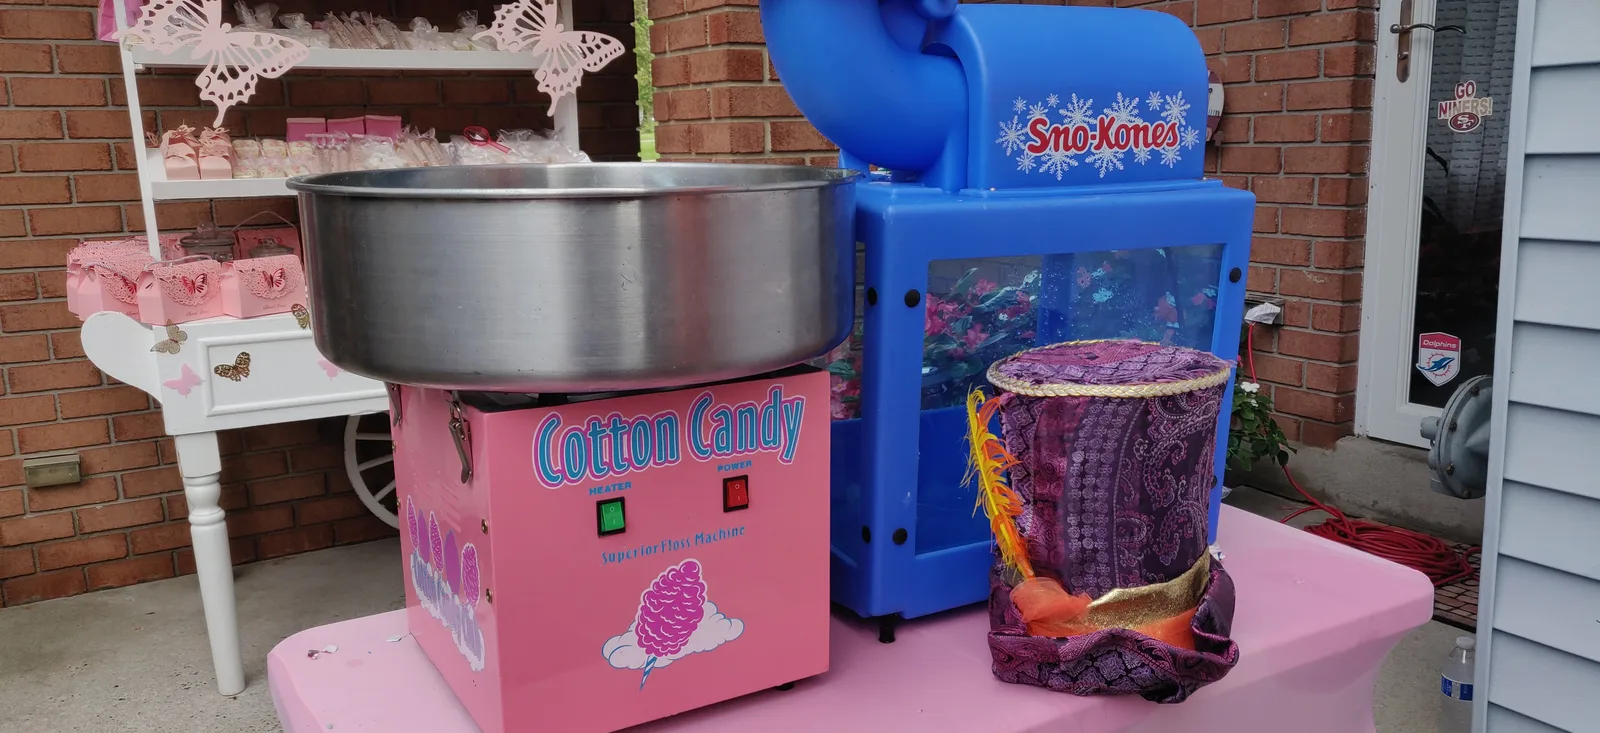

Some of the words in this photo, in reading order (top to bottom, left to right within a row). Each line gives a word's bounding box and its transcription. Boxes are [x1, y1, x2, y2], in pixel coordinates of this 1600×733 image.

[1456, 81, 1475, 99] GO
[1438, 98, 1493, 119] NINERS!
[1026, 115, 1179, 154] Sno-Kones
[1423, 340, 1457, 349] Dolphins
[532, 410, 682, 489] Cotton
[686, 384, 806, 464] Candy
[717, 460, 753, 472] POWER
[589, 481, 632, 495] HEATER
[695, 525, 745, 546] Machine
